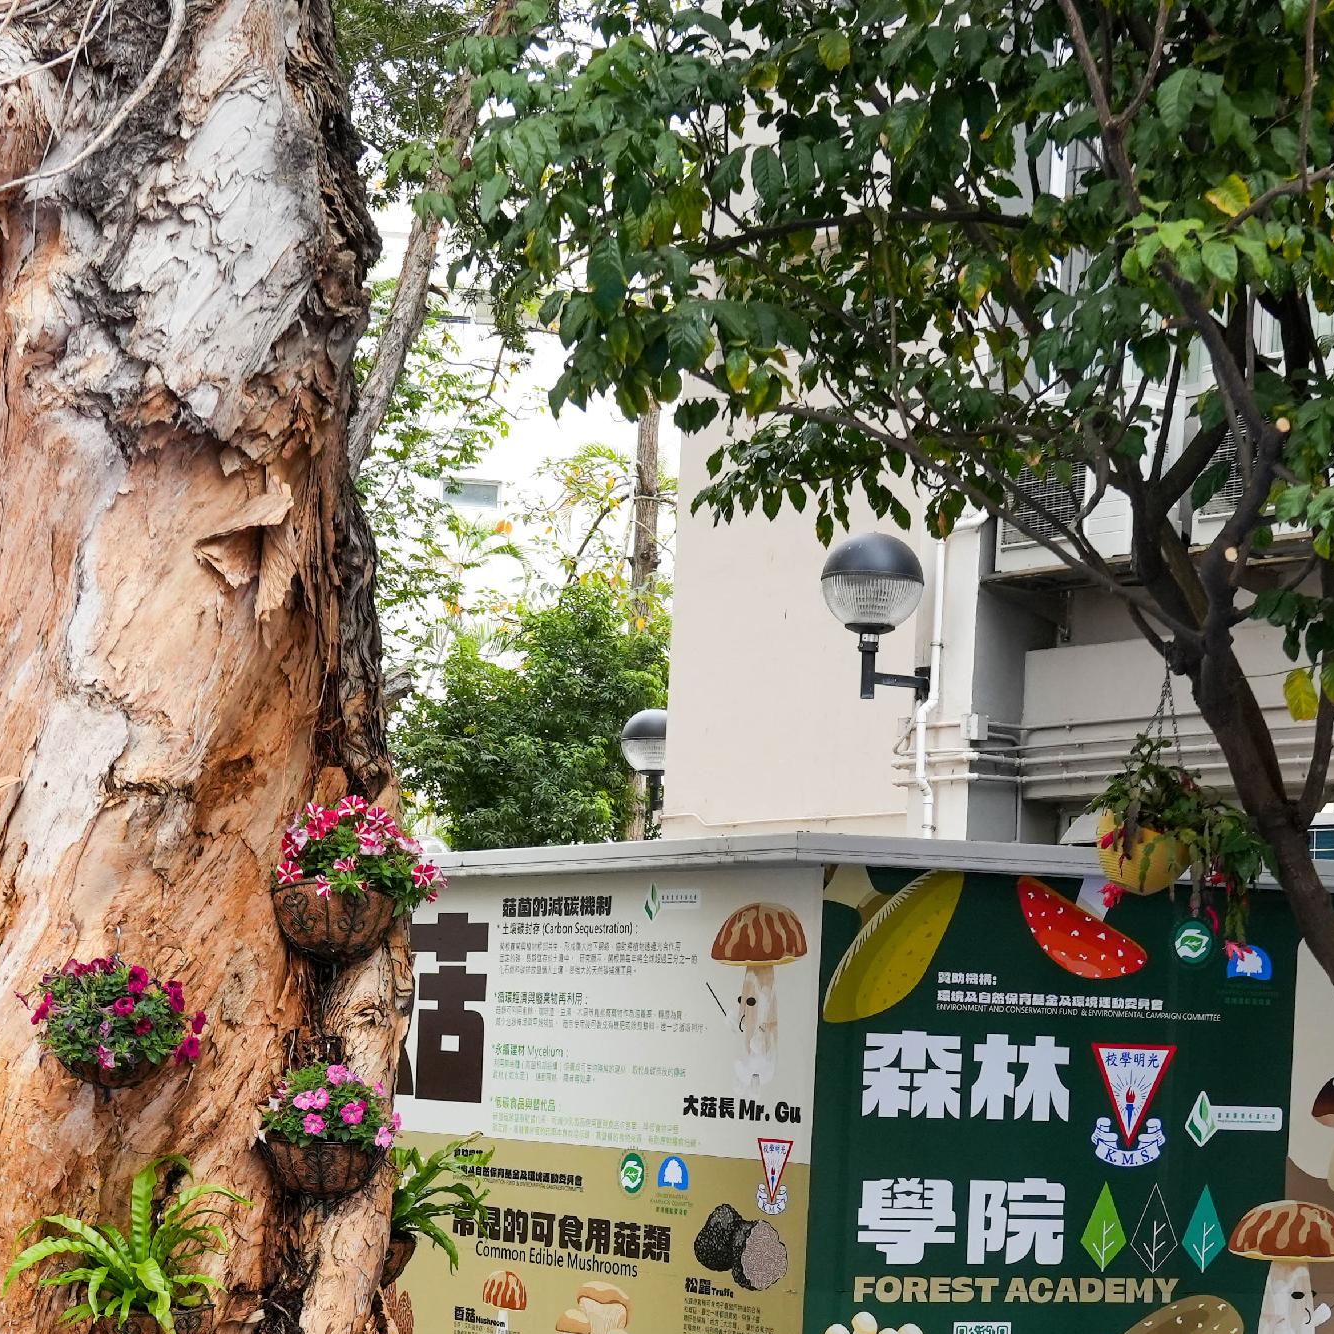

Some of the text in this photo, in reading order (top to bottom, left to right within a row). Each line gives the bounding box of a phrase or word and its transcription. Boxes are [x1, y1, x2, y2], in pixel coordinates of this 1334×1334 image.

[542, 921, 573, 937] (Carbon
[936, 1003, 1221, 1022] ENVIRONMENT AND CONSERVATION FUND & ENVIRONMENTAL CAMPAIGN COMMITTEE
[861, 1029, 1071, 1122] 森林
[683, 1094, 802, 1123] 大菇長 Mr. Gu
[857, 1177, 1065, 1266] 學院
[475, 1240, 638, 1278] Common Edible Mushrooms
[853, 1276, 1180, 1304] FOREST ACADEMY
